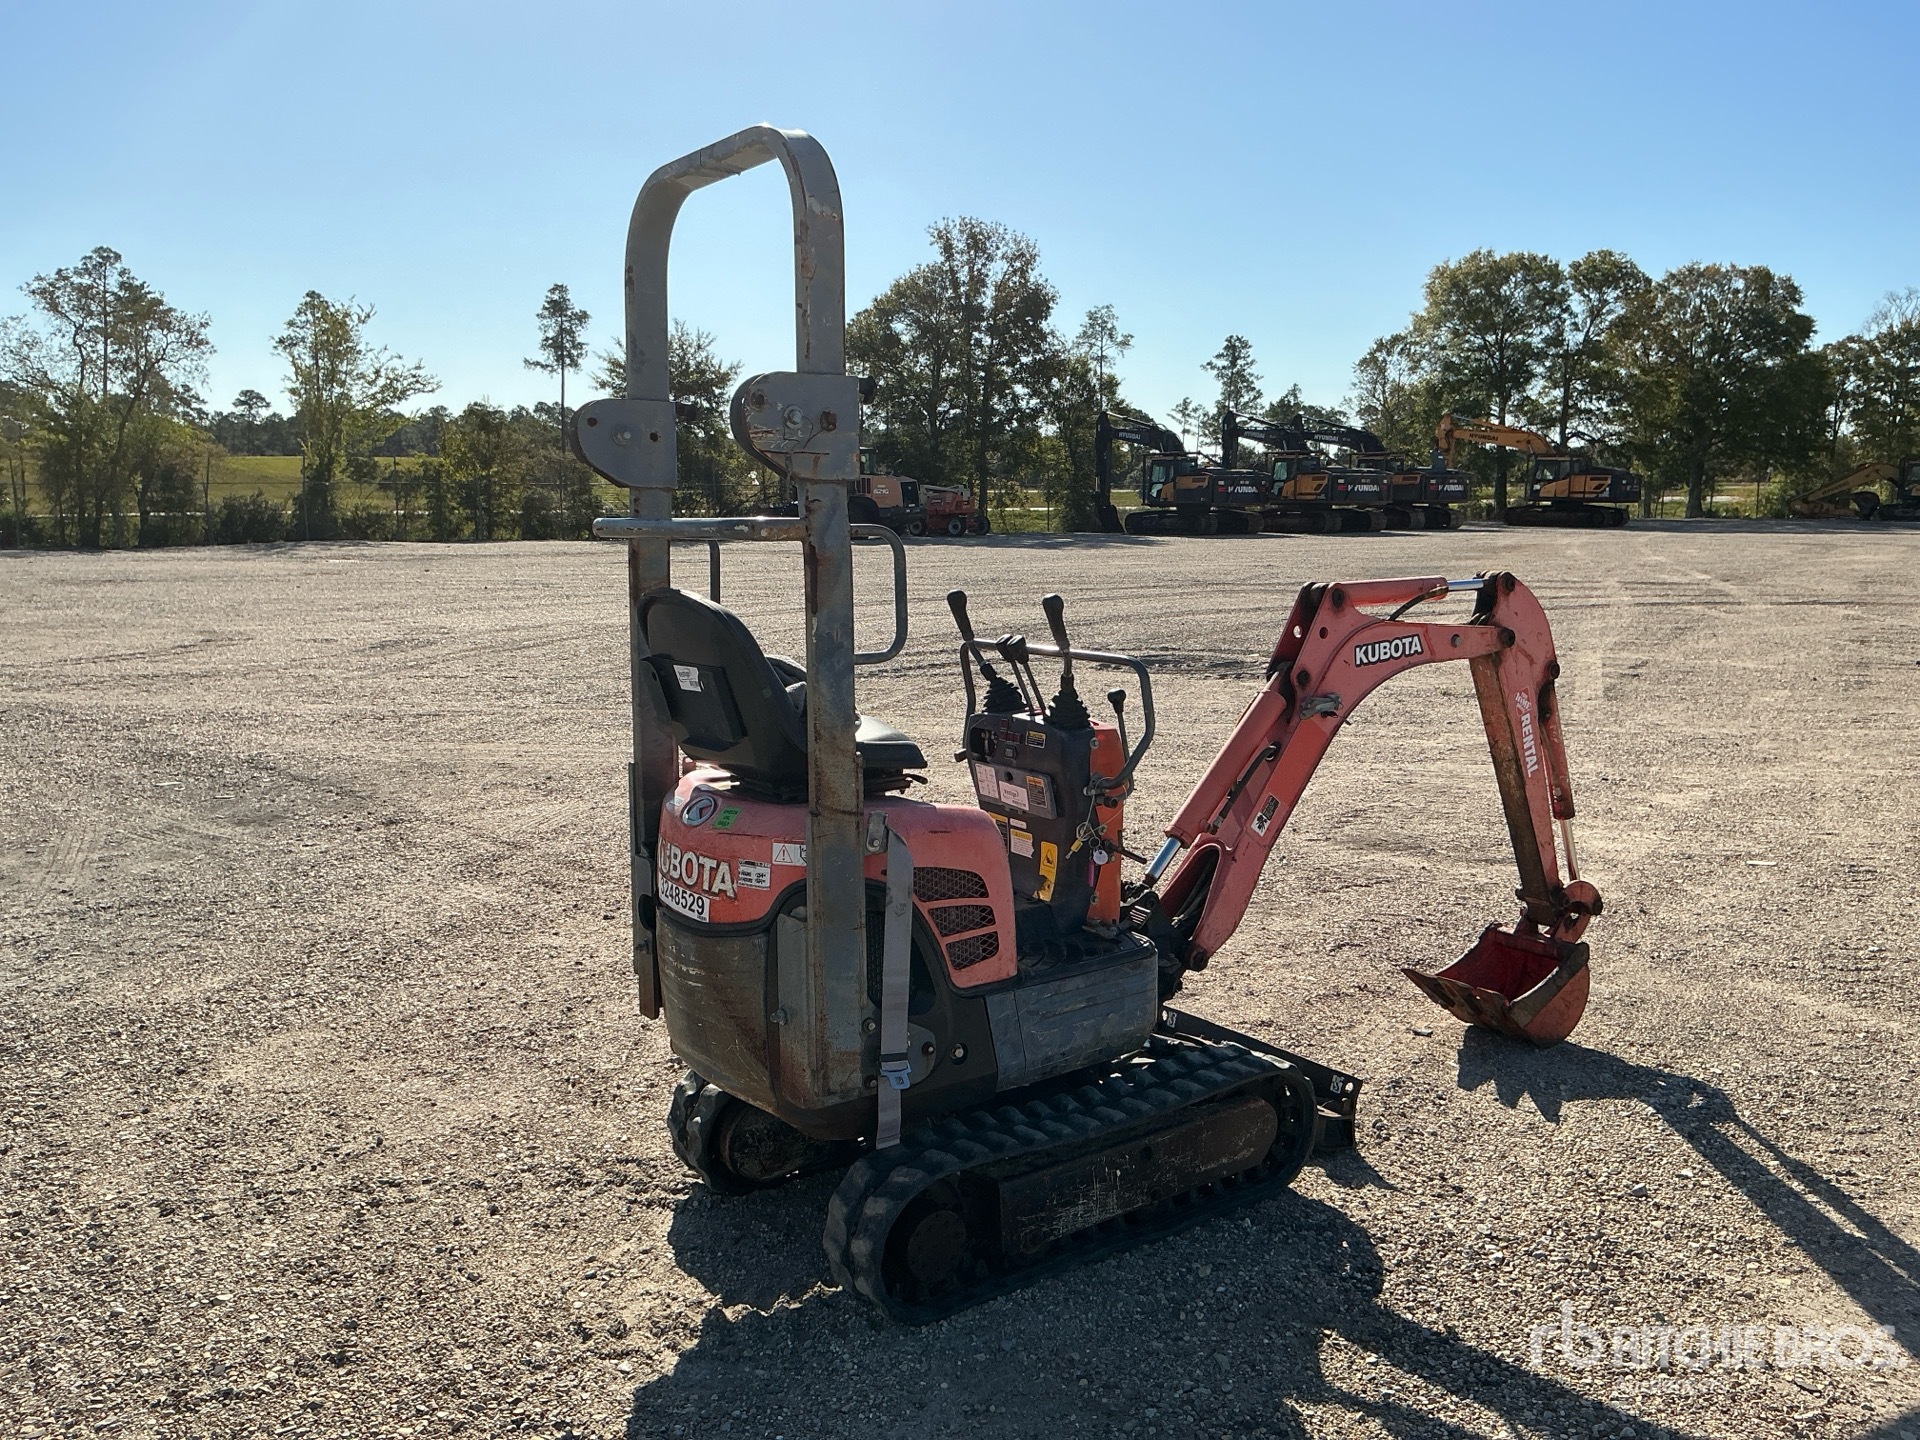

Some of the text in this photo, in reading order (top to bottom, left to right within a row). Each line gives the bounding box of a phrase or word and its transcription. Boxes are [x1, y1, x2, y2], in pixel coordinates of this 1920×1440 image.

[1355, 635, 1423, 666] KUBOTA
[1520, 712, 1539, 778] RENTAL
[660, 876, 705, 916] 3248529
